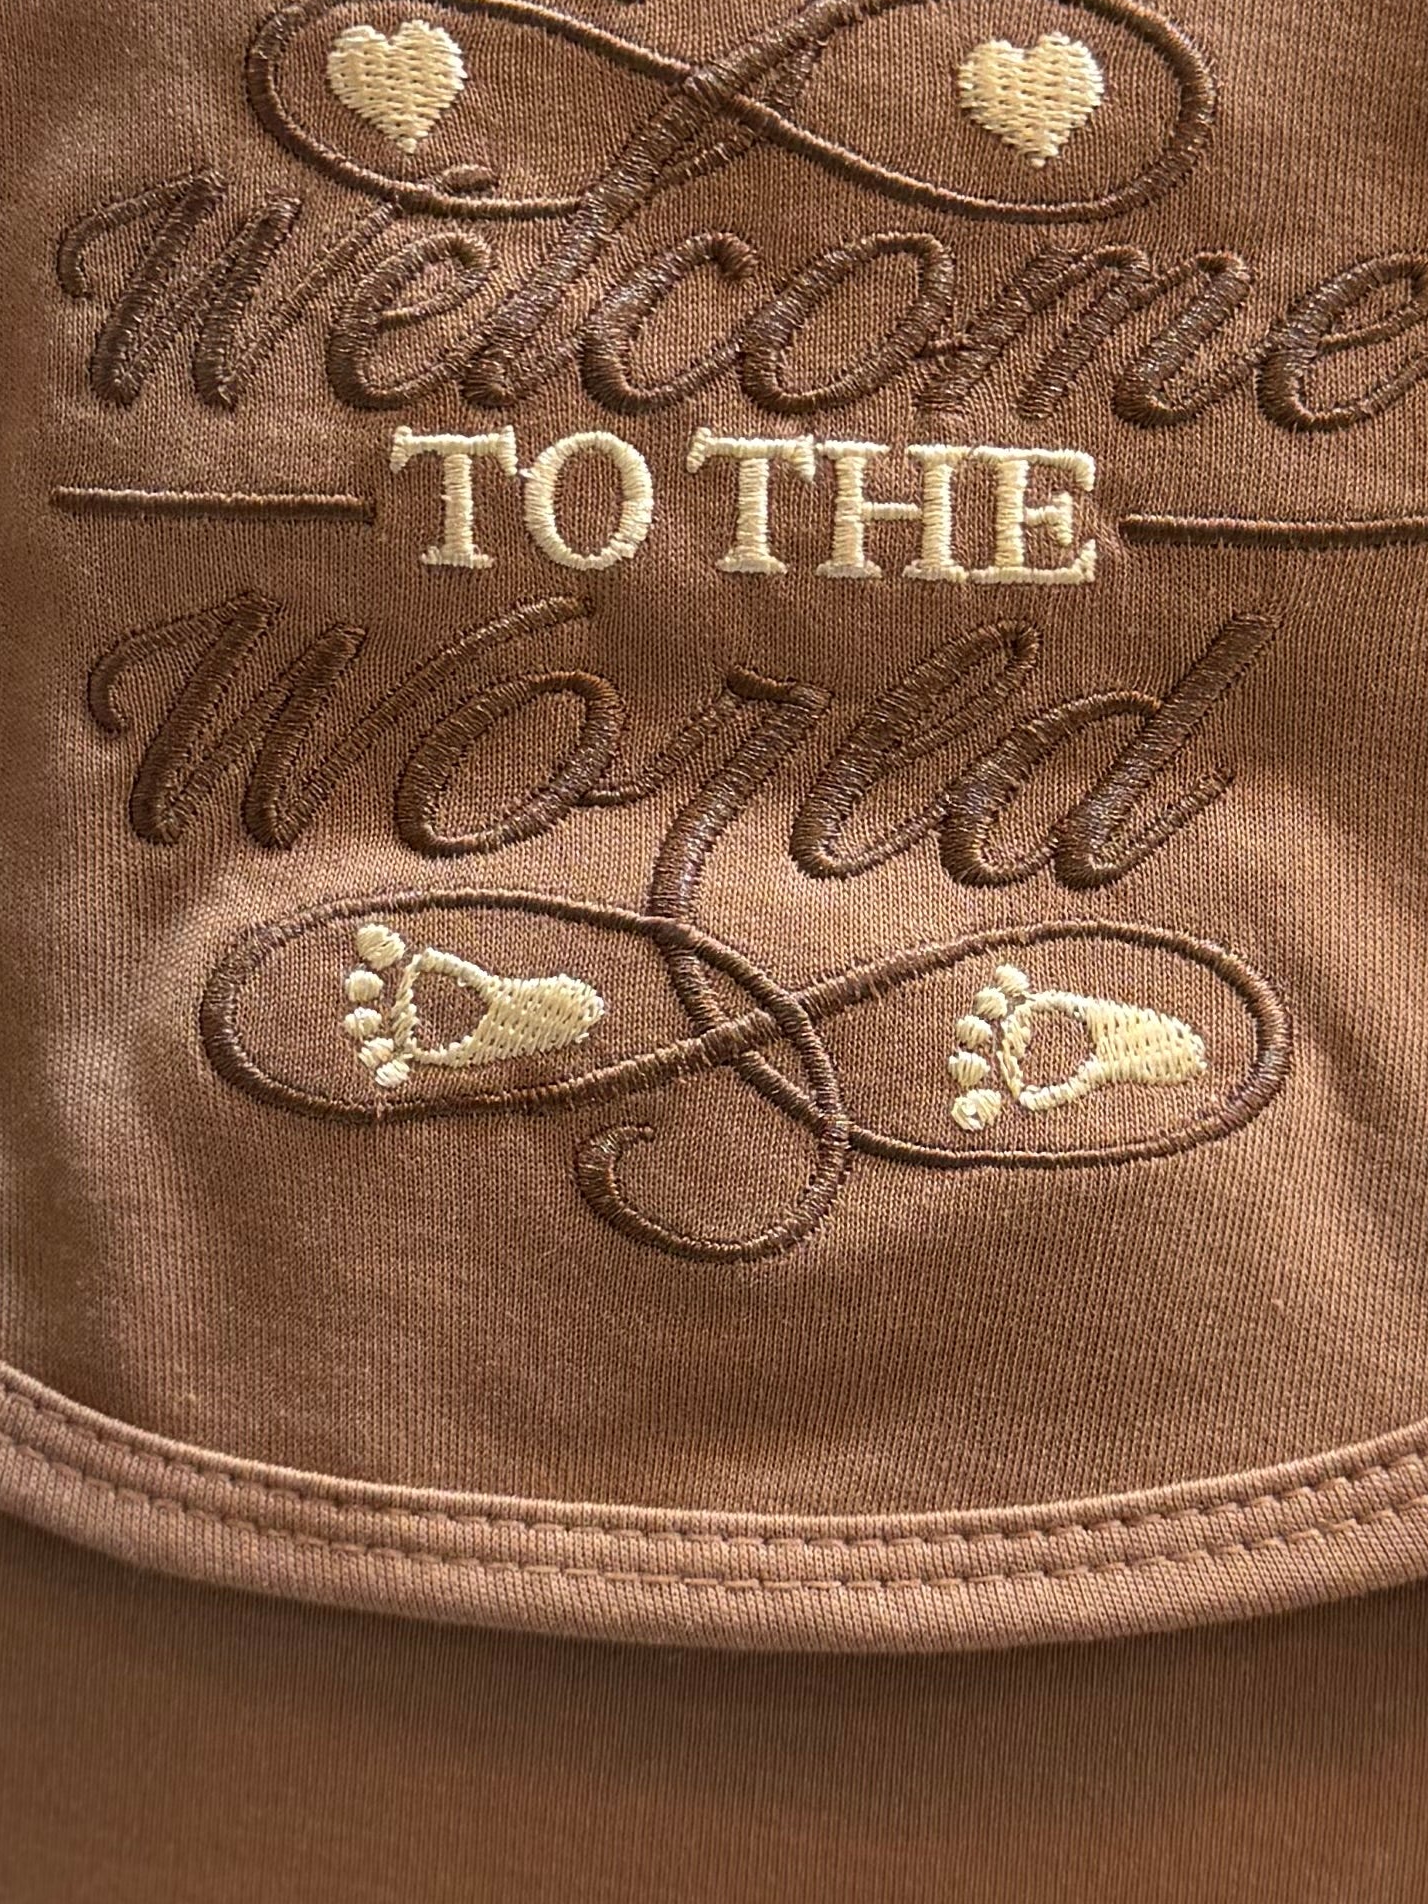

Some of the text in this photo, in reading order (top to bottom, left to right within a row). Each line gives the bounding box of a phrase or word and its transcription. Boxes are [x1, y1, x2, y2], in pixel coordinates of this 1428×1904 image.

[390, 423, 1099, 586] TO THE
[85, 589, 1280, 901] World
